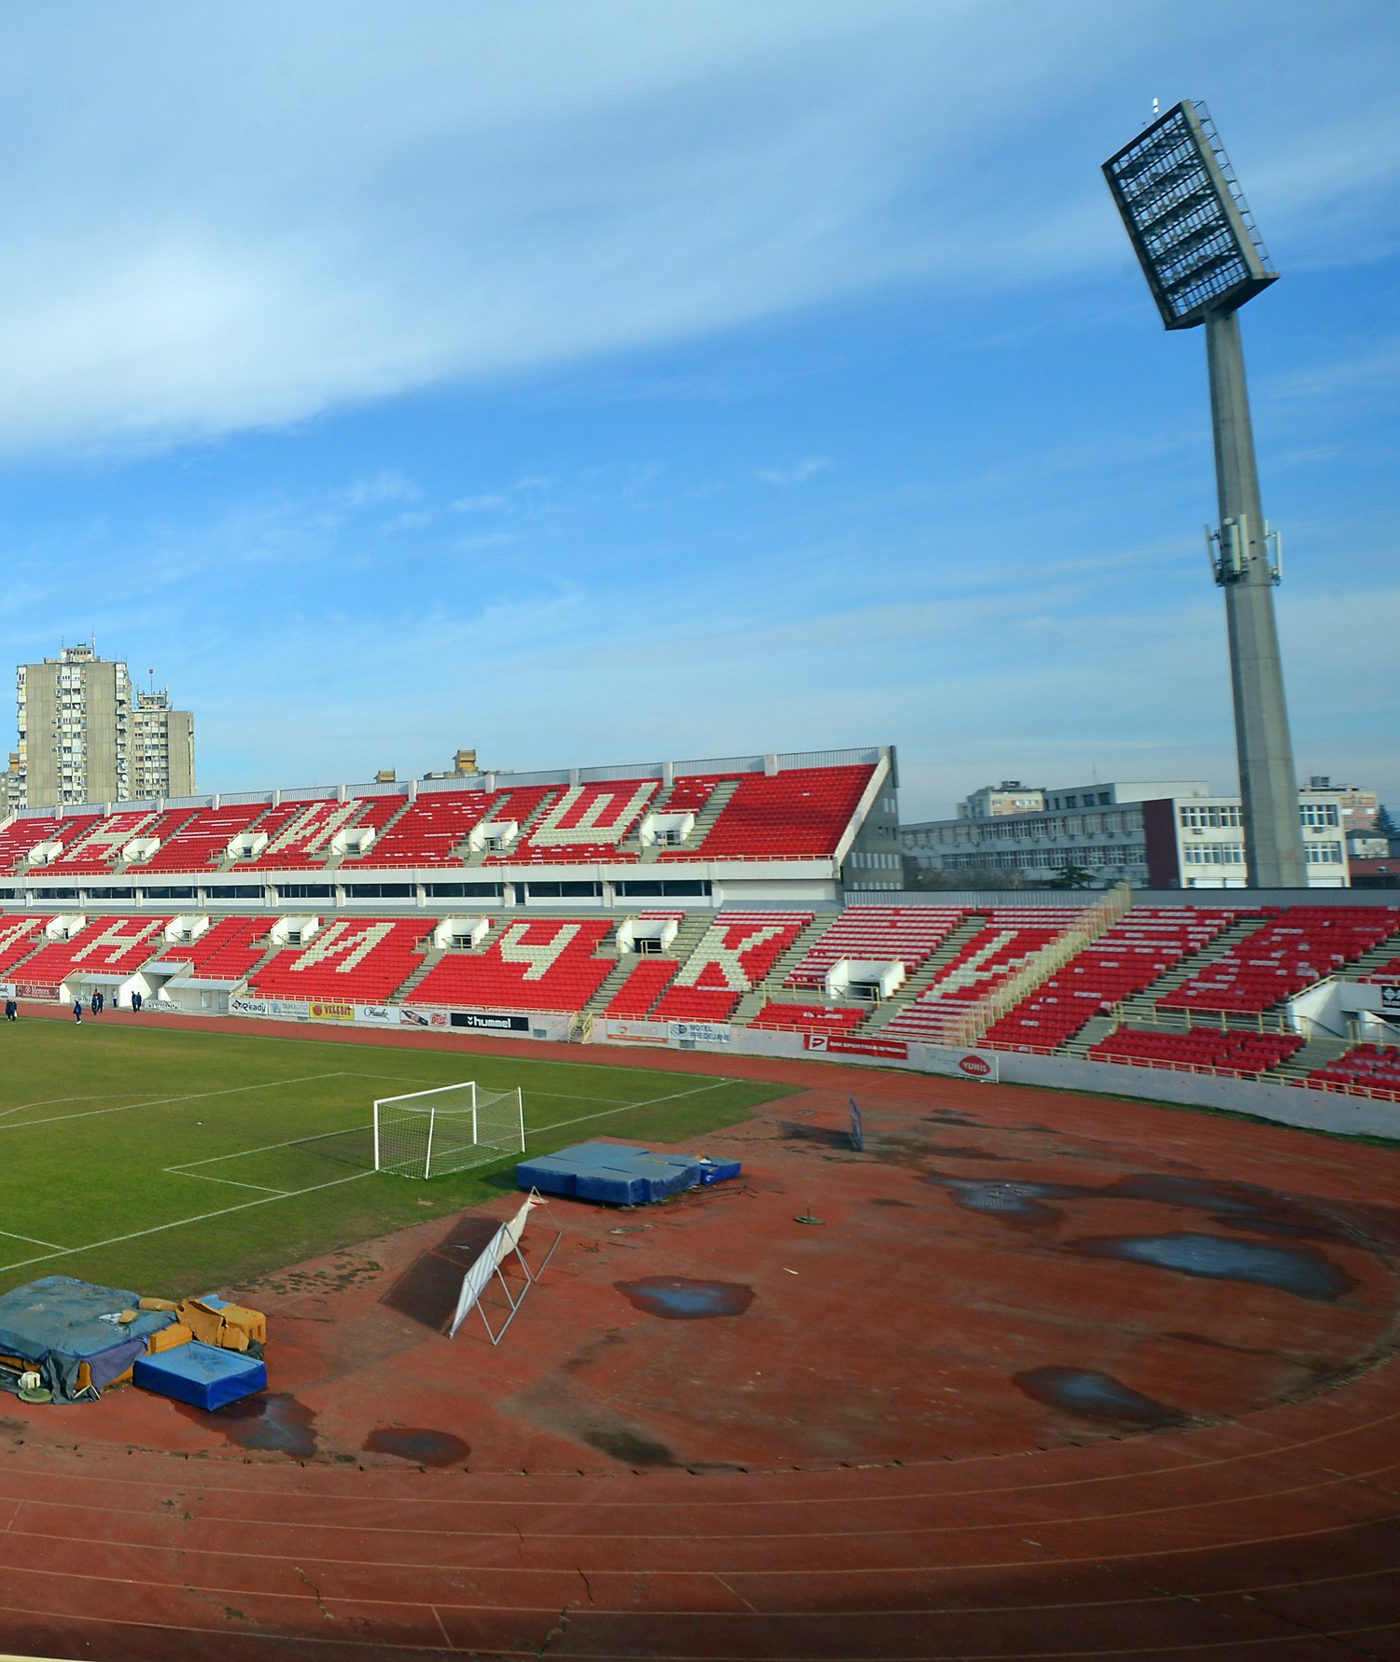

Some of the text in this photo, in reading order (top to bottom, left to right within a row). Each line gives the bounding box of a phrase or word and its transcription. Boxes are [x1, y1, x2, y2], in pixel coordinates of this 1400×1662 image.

[324, 1004, 351, 1017] VELEBIT
[473, 1016, 511, 1029] hummel
[690, 1024, 712, 1032] MOTEL
[690, 1032, 730, 1042] PREDEJANE
